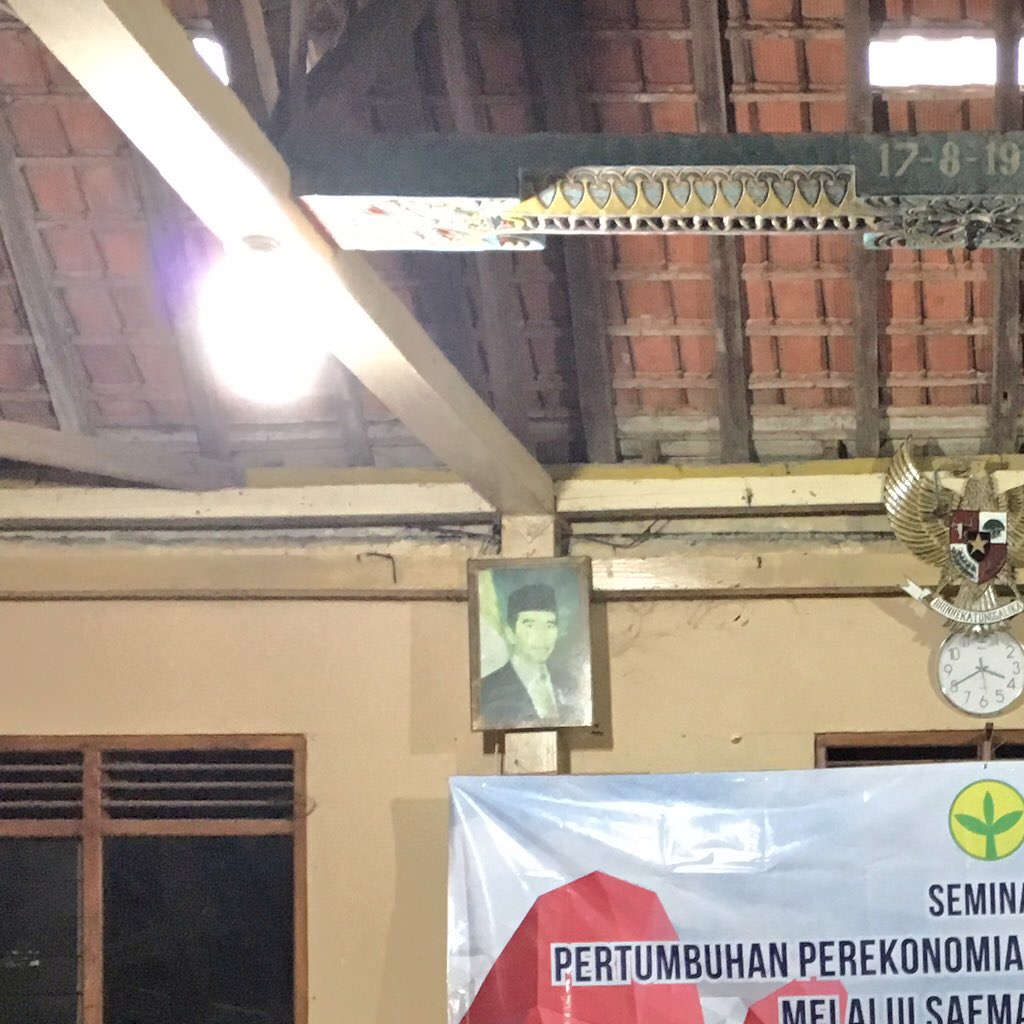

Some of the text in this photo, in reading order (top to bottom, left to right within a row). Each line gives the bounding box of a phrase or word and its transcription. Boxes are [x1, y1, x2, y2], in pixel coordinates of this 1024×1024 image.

[948, 647, 960, 661] 10
[1006, 645, 1014, 659] 2
[944, 664, 952, 677] 9
[1012, 661, 1020, 675] 3
[950, 680, 958, 693] 8
[1006, 677, 1016, 690] 4
[964, 691, 971, 704] 7
[979, 696, 989, 708] 6
[995, 690, 1004, 703] 5
[555, 943, 787, 981] PERTUMBUHAN
